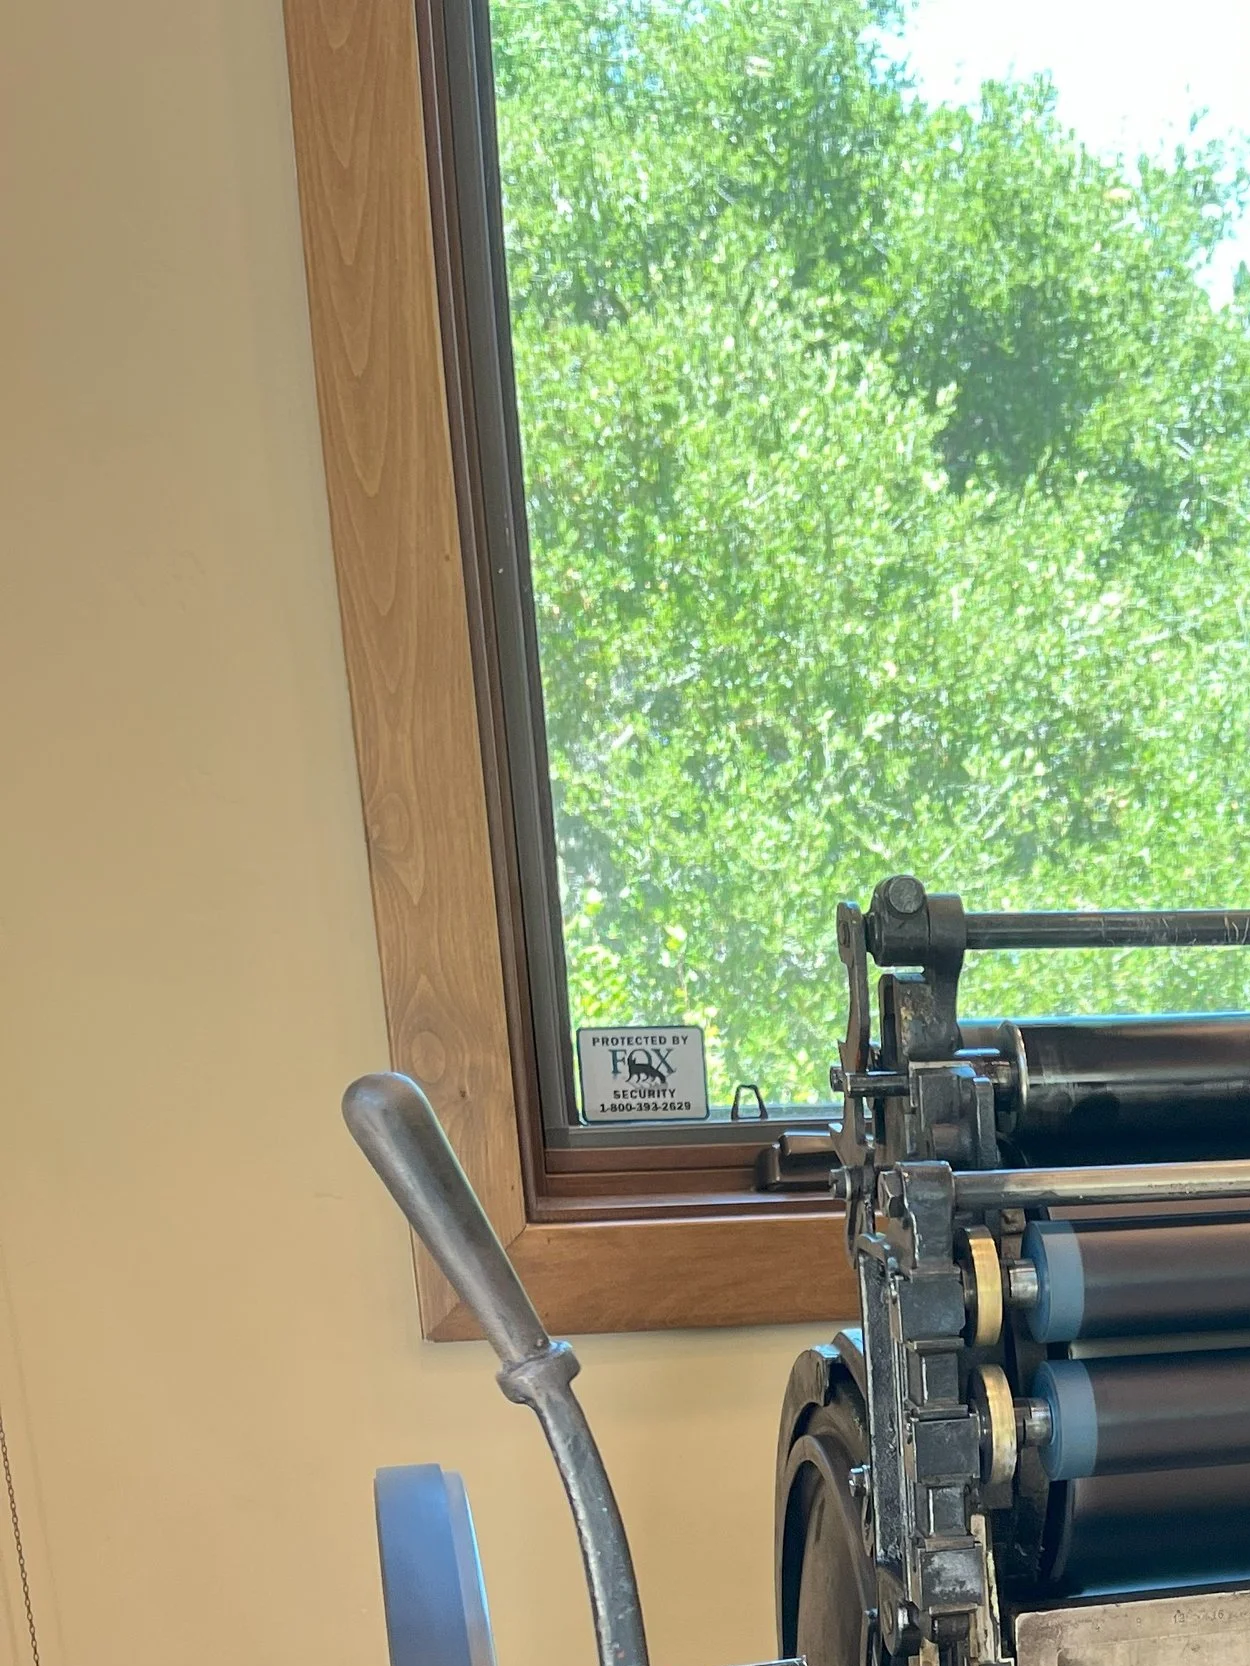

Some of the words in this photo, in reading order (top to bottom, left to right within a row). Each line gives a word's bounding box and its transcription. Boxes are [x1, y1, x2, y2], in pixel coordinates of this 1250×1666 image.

[592, 1036, 667, 1047] PROTECTED
[672, 1035, 689, 1045] BY
[608, 1048, 677, 1076] FOX
[613, 1088, 676, 1100] SECURITY
